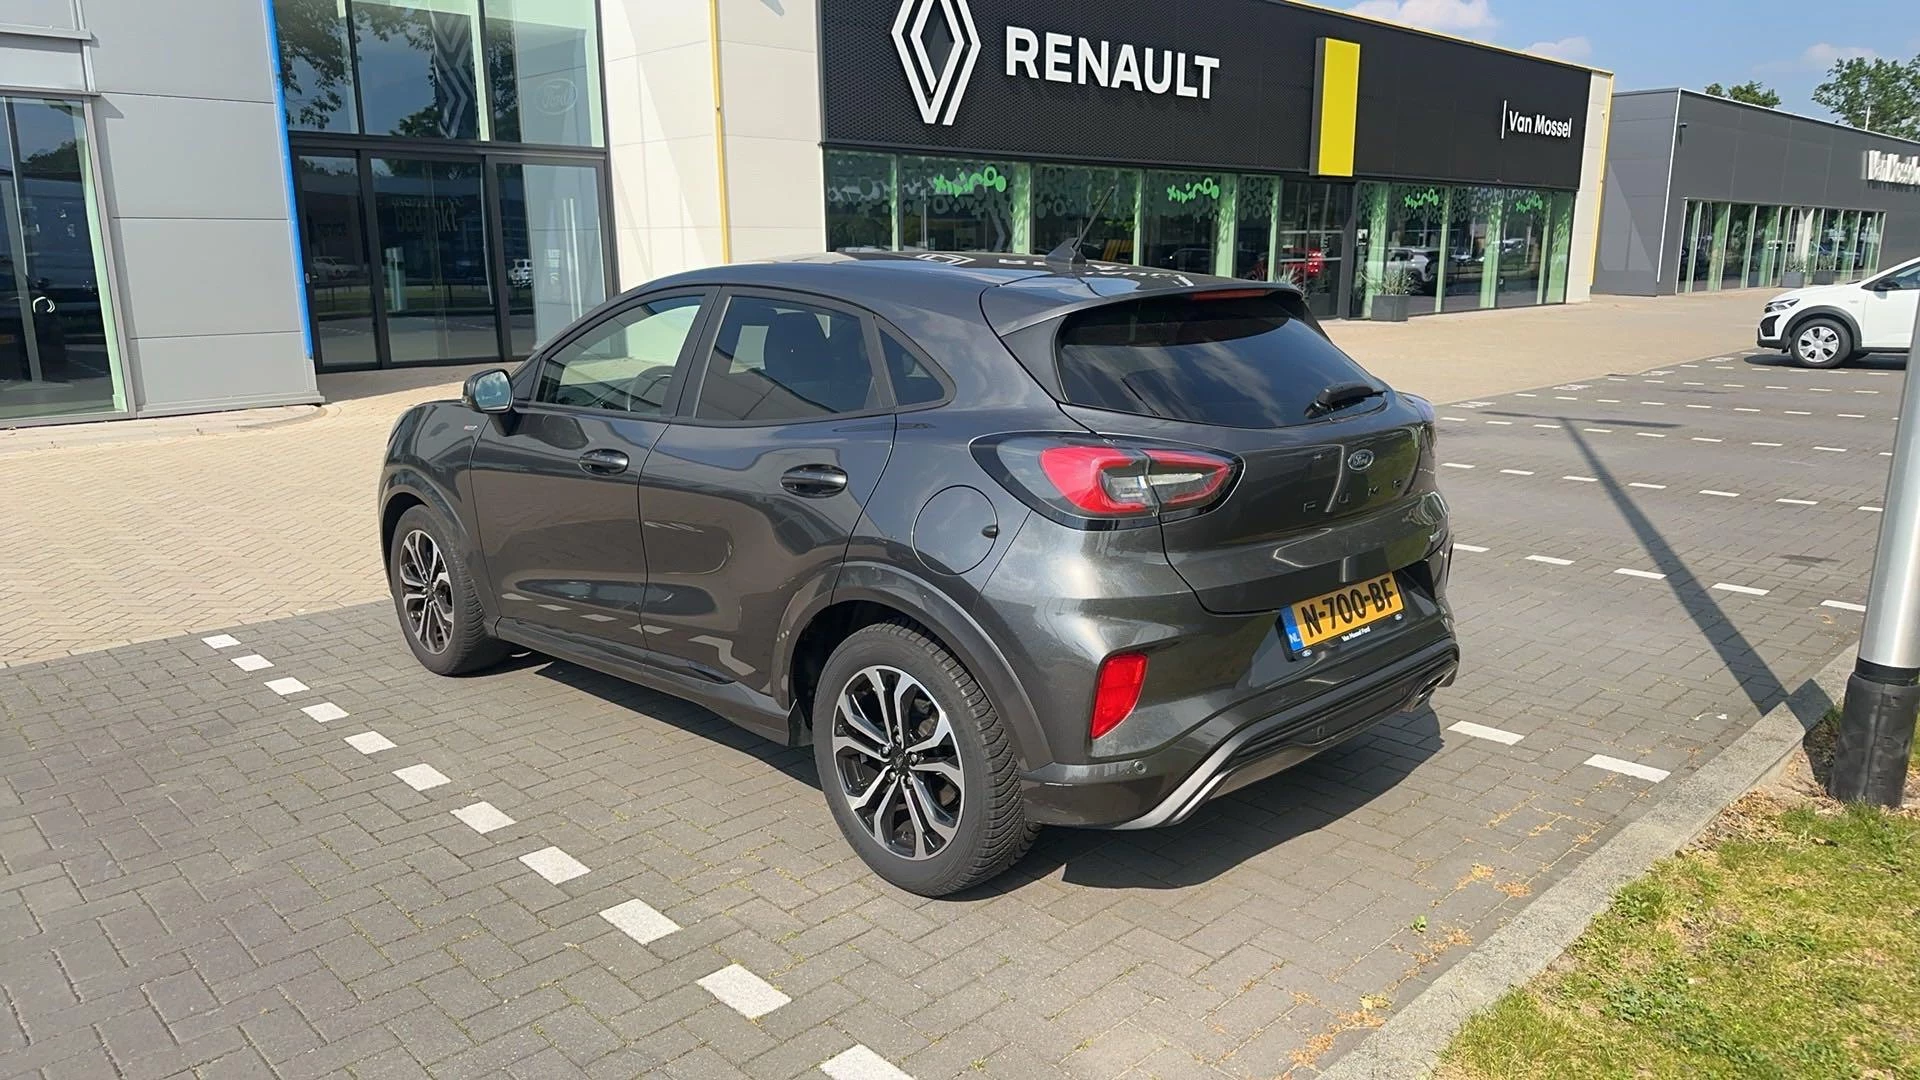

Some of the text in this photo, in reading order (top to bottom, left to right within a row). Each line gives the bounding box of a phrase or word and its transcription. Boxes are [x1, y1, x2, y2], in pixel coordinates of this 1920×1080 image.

[1006, 25, 1220, 99] RENAULT
[1509, 110, 1572, 138] Van Mossel
[1301, 578, 1394, 638] N-700-BF
[1288, 632, 1301, 644] NL
